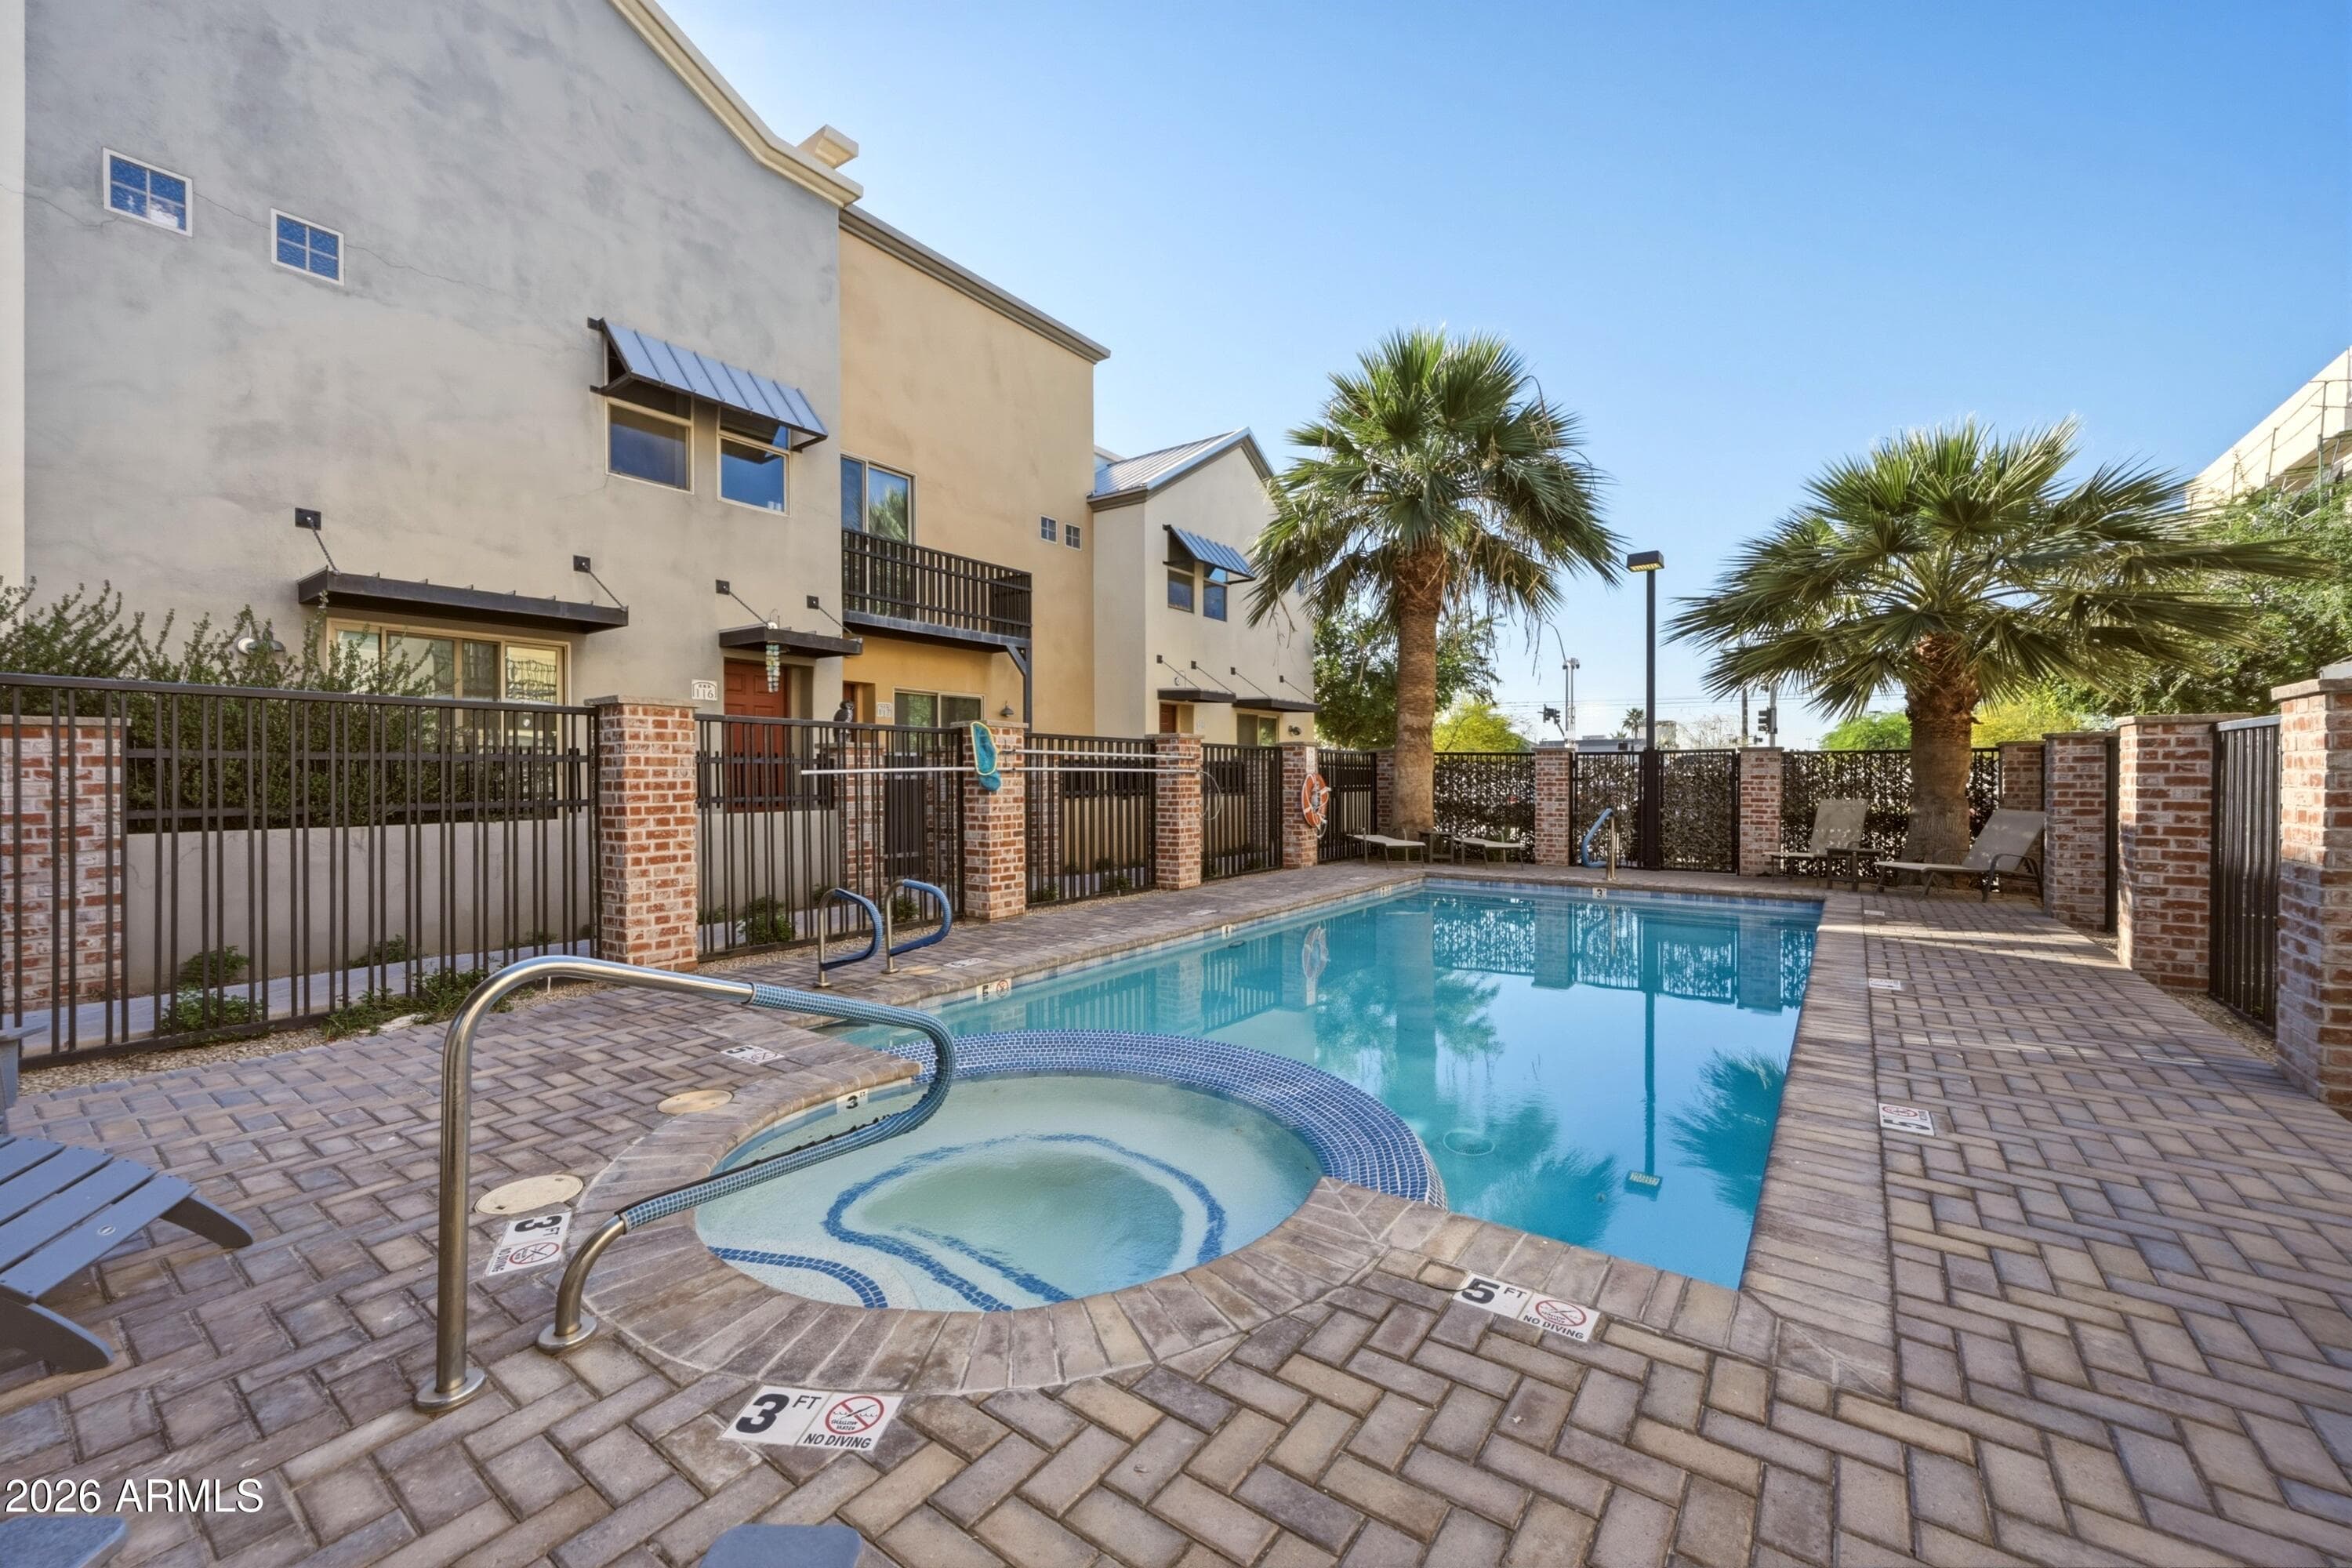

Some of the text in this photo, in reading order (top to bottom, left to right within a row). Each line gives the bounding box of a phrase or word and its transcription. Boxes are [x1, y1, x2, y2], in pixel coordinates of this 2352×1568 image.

[696, 688, 715, 699] 116
[1596, 888, 1603, 898] 3
[846, 1094, 858, 1109] 3
[514, 1215, 563, 1236] 3 FT
[1461, 1277, 1528, 1305] 5 FT
[1523, 1314, 1541, 1325] NO
[1542, 1321, 1584, 1340] DIVING
[735, 1393, 822, 1434] 3 FT
[803, 1433, 872, 1449] NO DIVING
